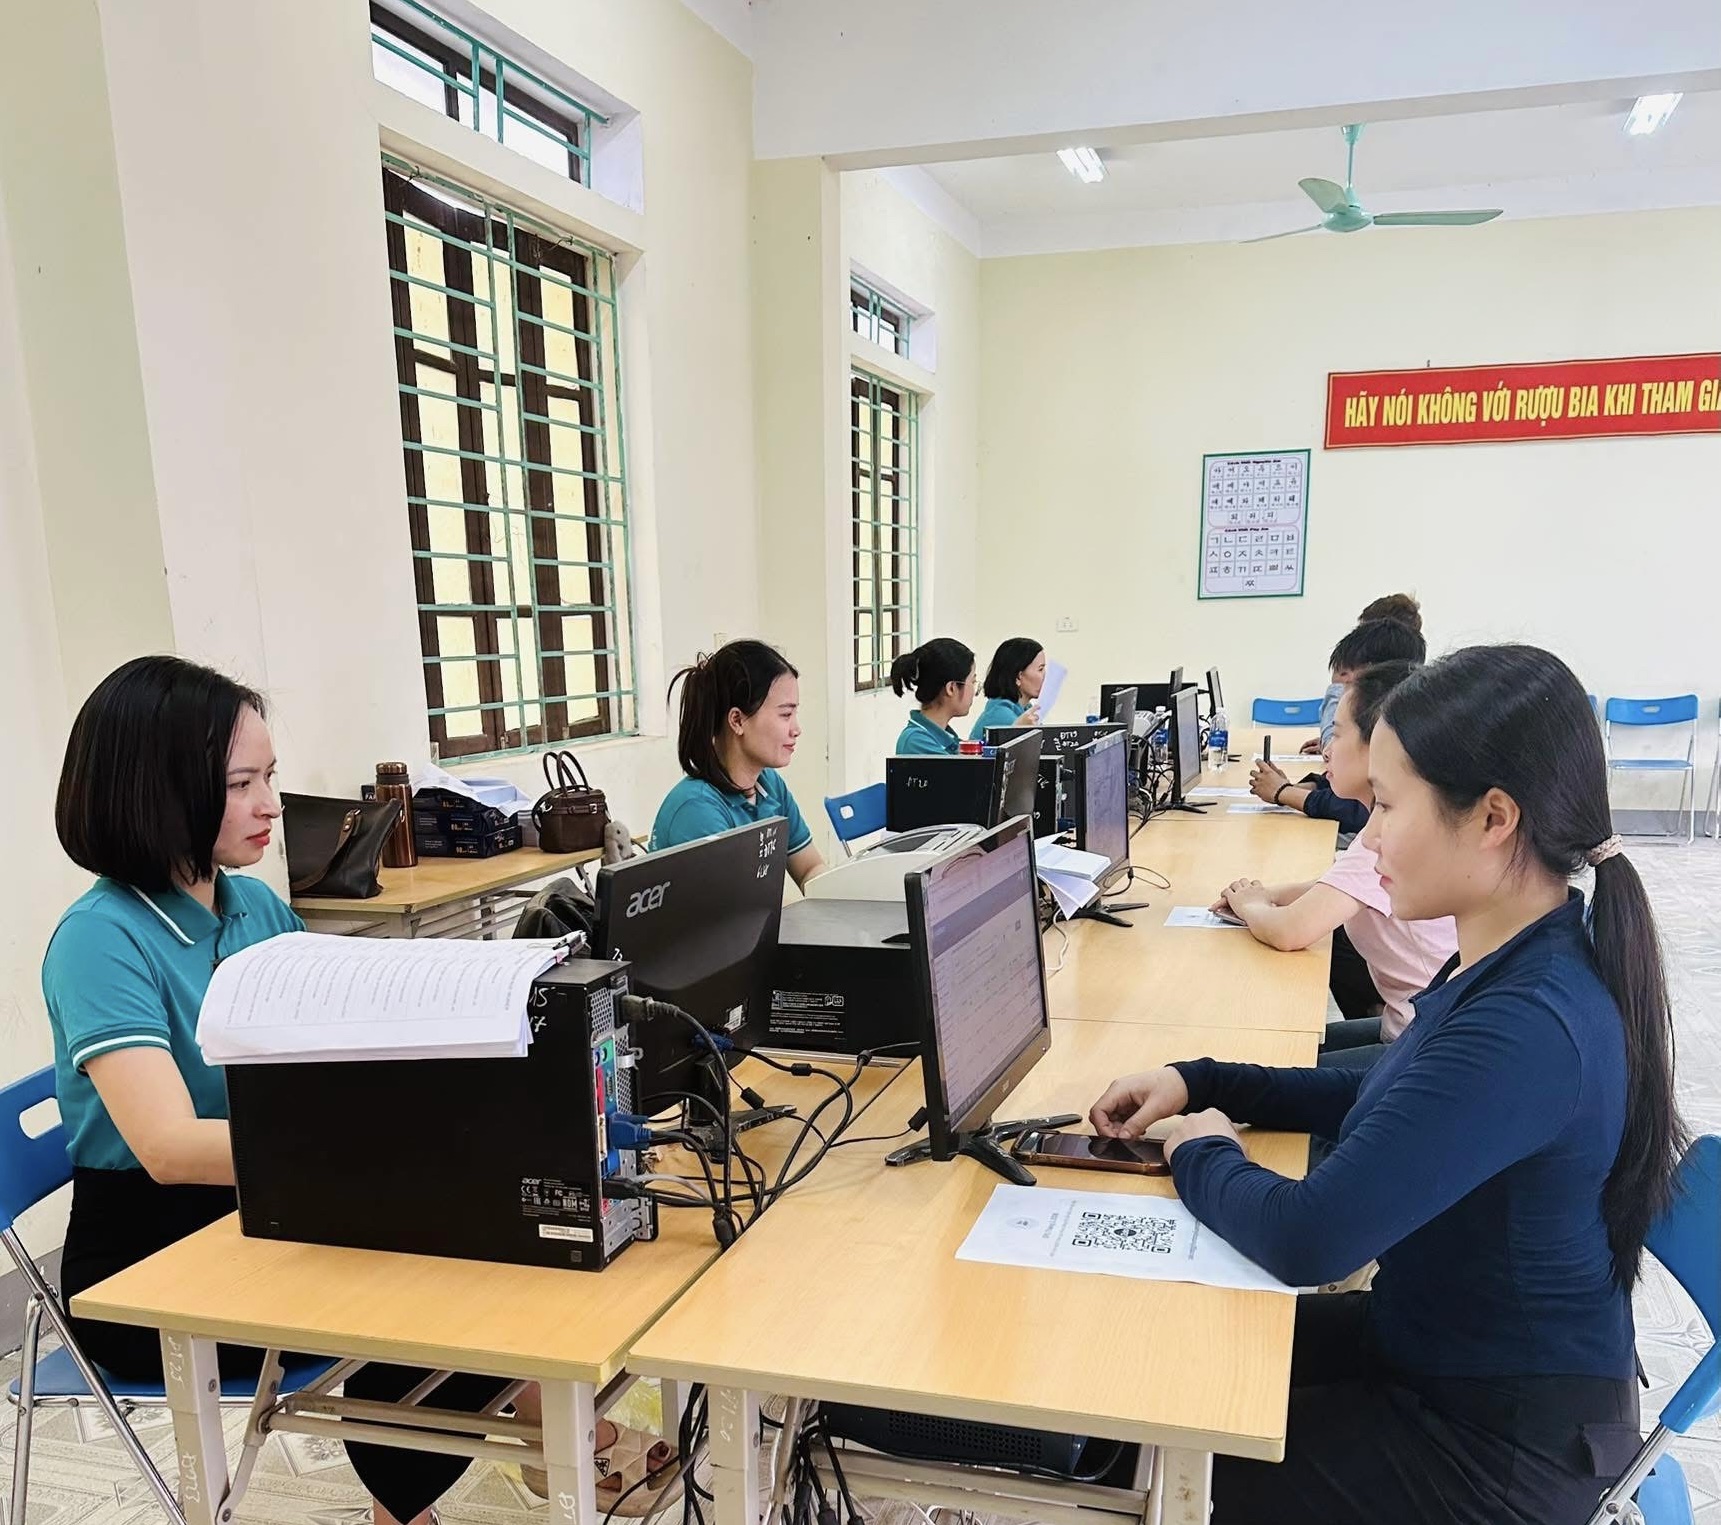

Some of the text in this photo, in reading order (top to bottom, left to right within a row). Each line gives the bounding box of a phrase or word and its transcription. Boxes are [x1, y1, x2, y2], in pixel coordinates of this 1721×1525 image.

[1344, 390, 1380, 428] HÃY
[1382, 388, 1414, 427] NÓI
[1416, 386, 1478, 425] KHÔNG
[1482, 380, 1512, 423] VỚI
[1514, 384, 1565, 427] RƯỢU
[1567, 385, 1599, 418] BIA
[1603, 383, 1637, 416] KHI
[1641, 380, 1695, 415] THAM
[626, 881, 671, 918] acer
